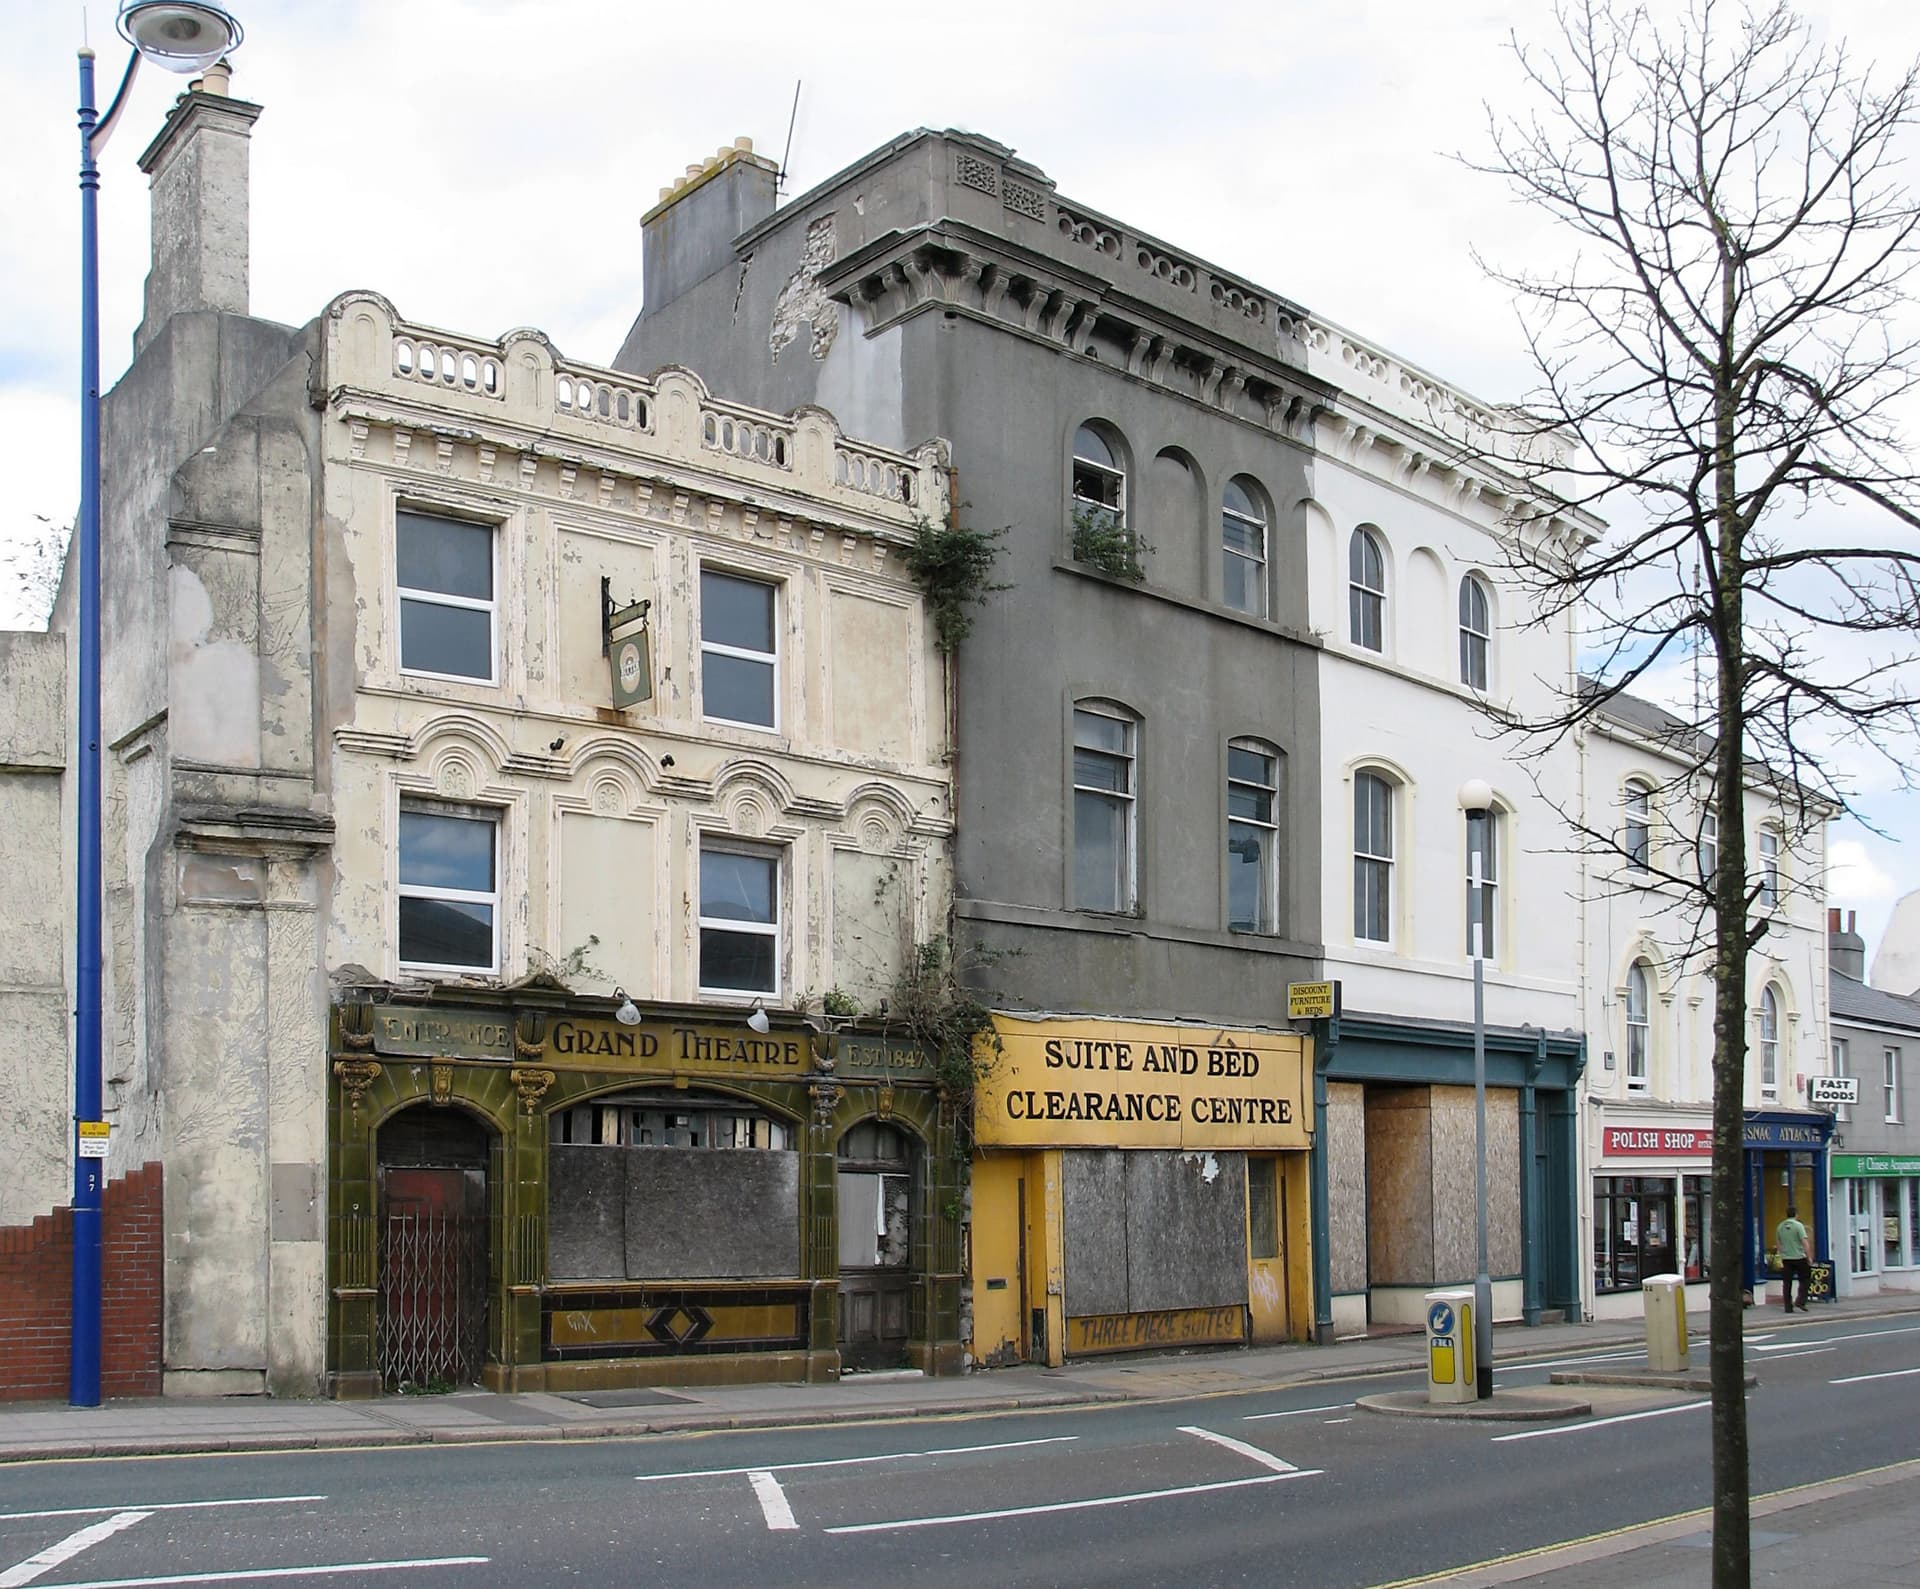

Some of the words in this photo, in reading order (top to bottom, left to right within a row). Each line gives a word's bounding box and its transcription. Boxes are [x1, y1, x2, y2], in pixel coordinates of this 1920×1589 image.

[1293, 985, 1328, 996] DISCOUNT
[1290, 995, 1331, 1006] FURNITURE
[1304, 1006, 1324, 1015] BEDS
[552, 1021, 658, 1058] GRAND
[672, 1028, 800, 1065] THEATRE
[888, 1049, 925, 1069] 1847
[1045, 1039, 1133, 1071] SUITE
[1142, 1046, 1199, 1076] AND
[1206, 1050, 1260, 1078] BED
[1820, 1079, 1851, 1089] FAST
[1815, 1090, 1855, 1101] FOODS
[1006, 1089, 1182, 1122] CLEARANCE
[1191, 1096, 1293, 1125] CENTRE
[1612, 1131, 1659, 1149] POLISH
[1664, 1132, 1695, 1150] SHOP
[1079, 1315, 1133, 1347] THREE
[1135, 1311, 1179, 1342] PIECE
[1181, 1308, 1235, 1338] SUITES
